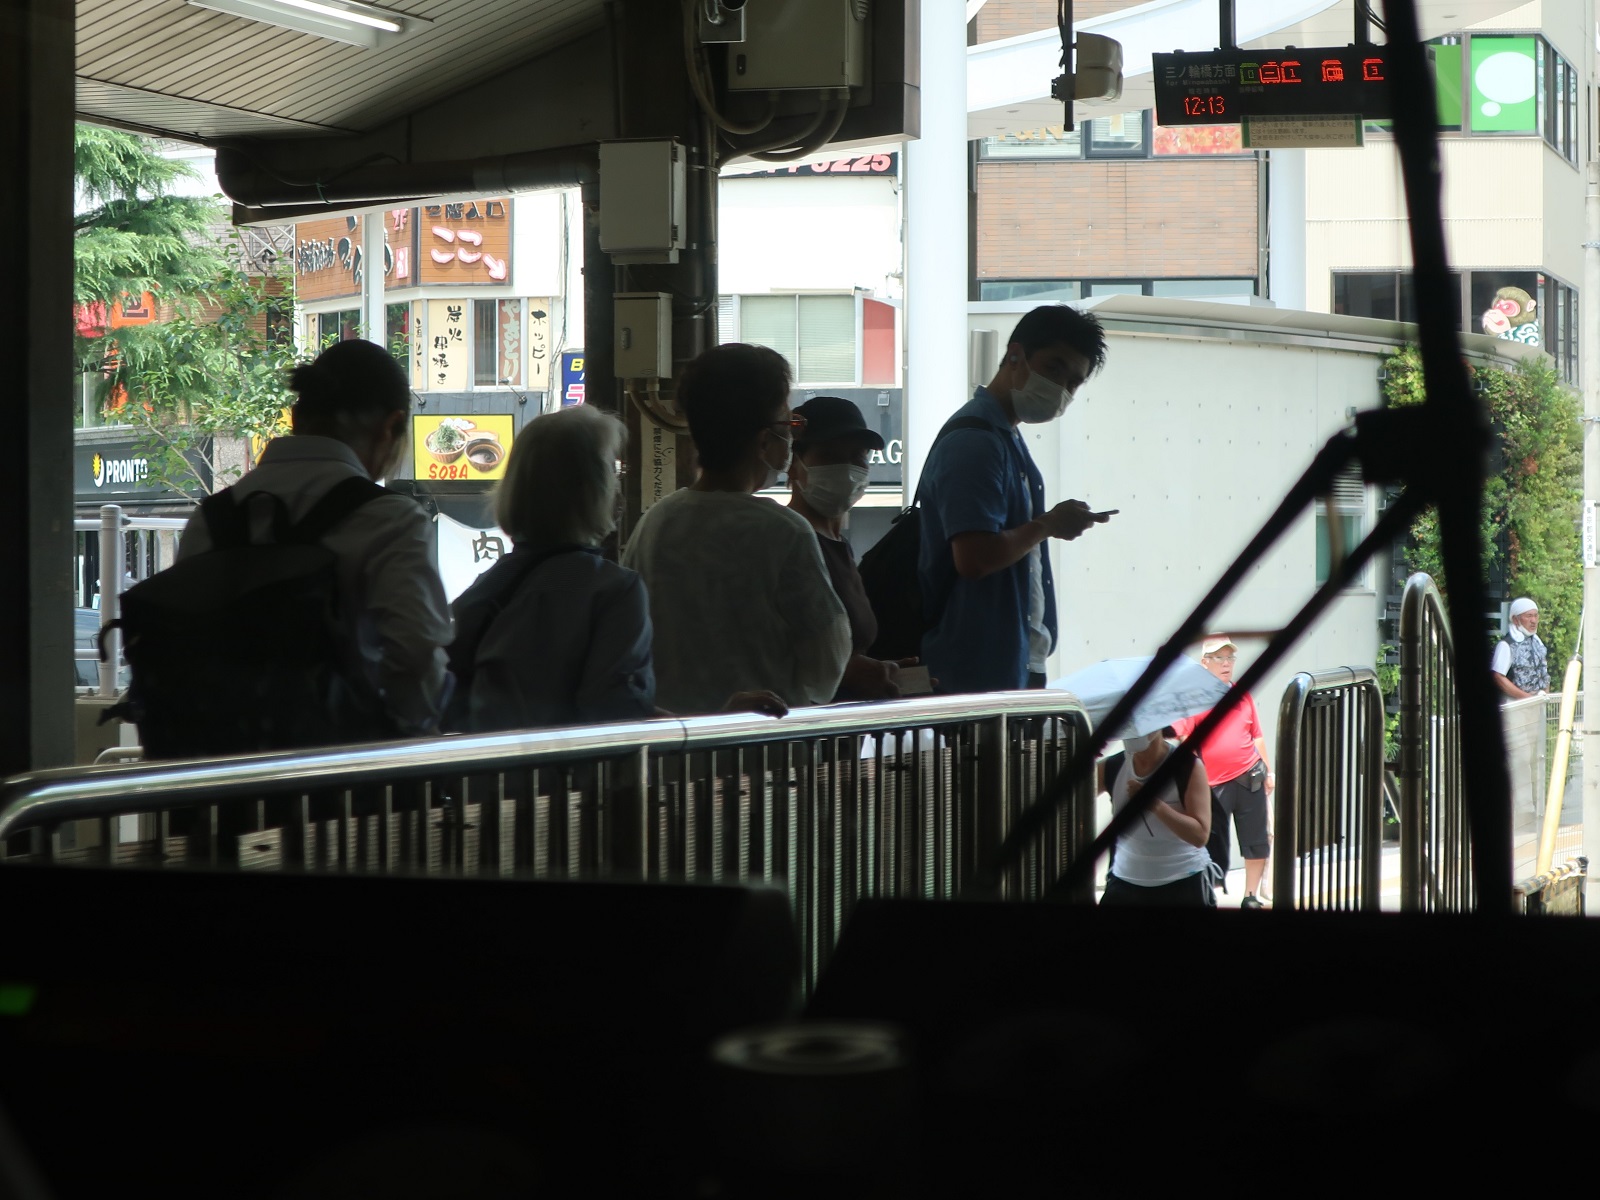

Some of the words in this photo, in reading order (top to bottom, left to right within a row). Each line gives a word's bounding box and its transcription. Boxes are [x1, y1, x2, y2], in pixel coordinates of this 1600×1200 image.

[1165, 64, 1236, 79] 三ノ輪橋方面
[1184, 96, 1225, 115] 12:13
[430, 225, 483, 264] ここ
[531, 309, 548, 375] ホッピー
[105, 458, 149, 484] PRONTO
[428, 463, 468, 480] SOBA
[472, 531, 505, 564] 肉
